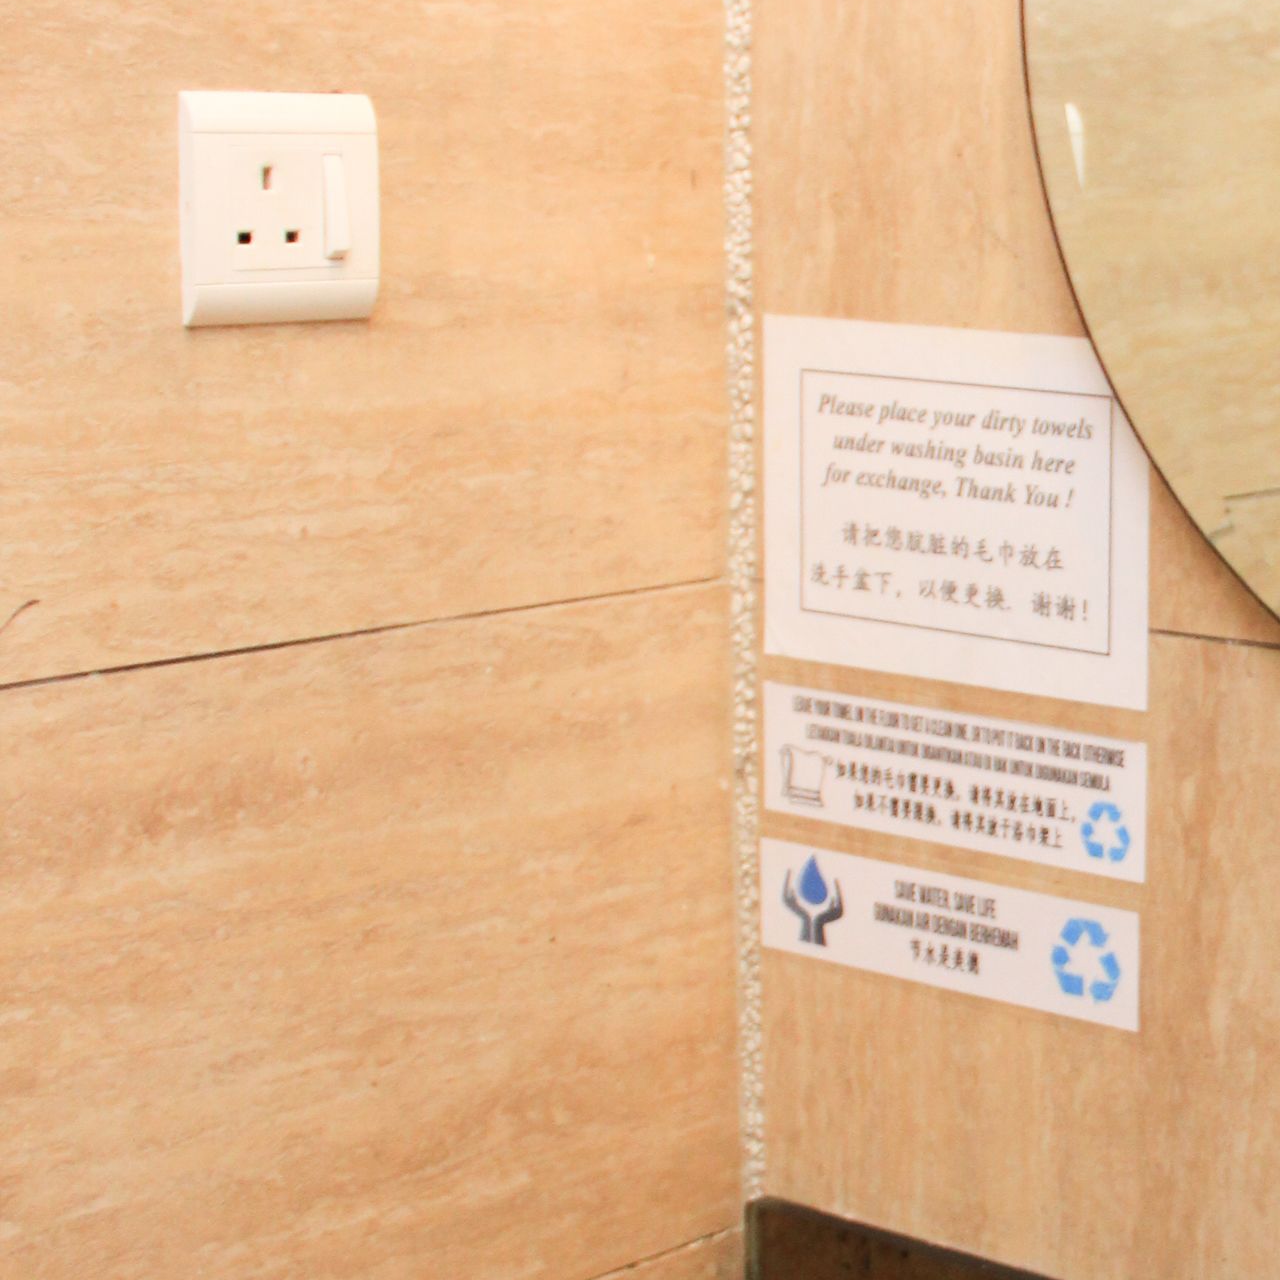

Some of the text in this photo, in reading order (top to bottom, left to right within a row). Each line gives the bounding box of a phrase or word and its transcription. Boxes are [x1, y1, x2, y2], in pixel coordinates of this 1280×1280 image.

[818, 393, 1093, 440] Please place your dirty towels
[833, 432, 1076, 475] under washing basin here
[821, 462, 850, 488] for
[855, 469, 947, 499] exchange,
[955, 476, 1016, 504] Thank
[1024, 483, 1059, 508] You
